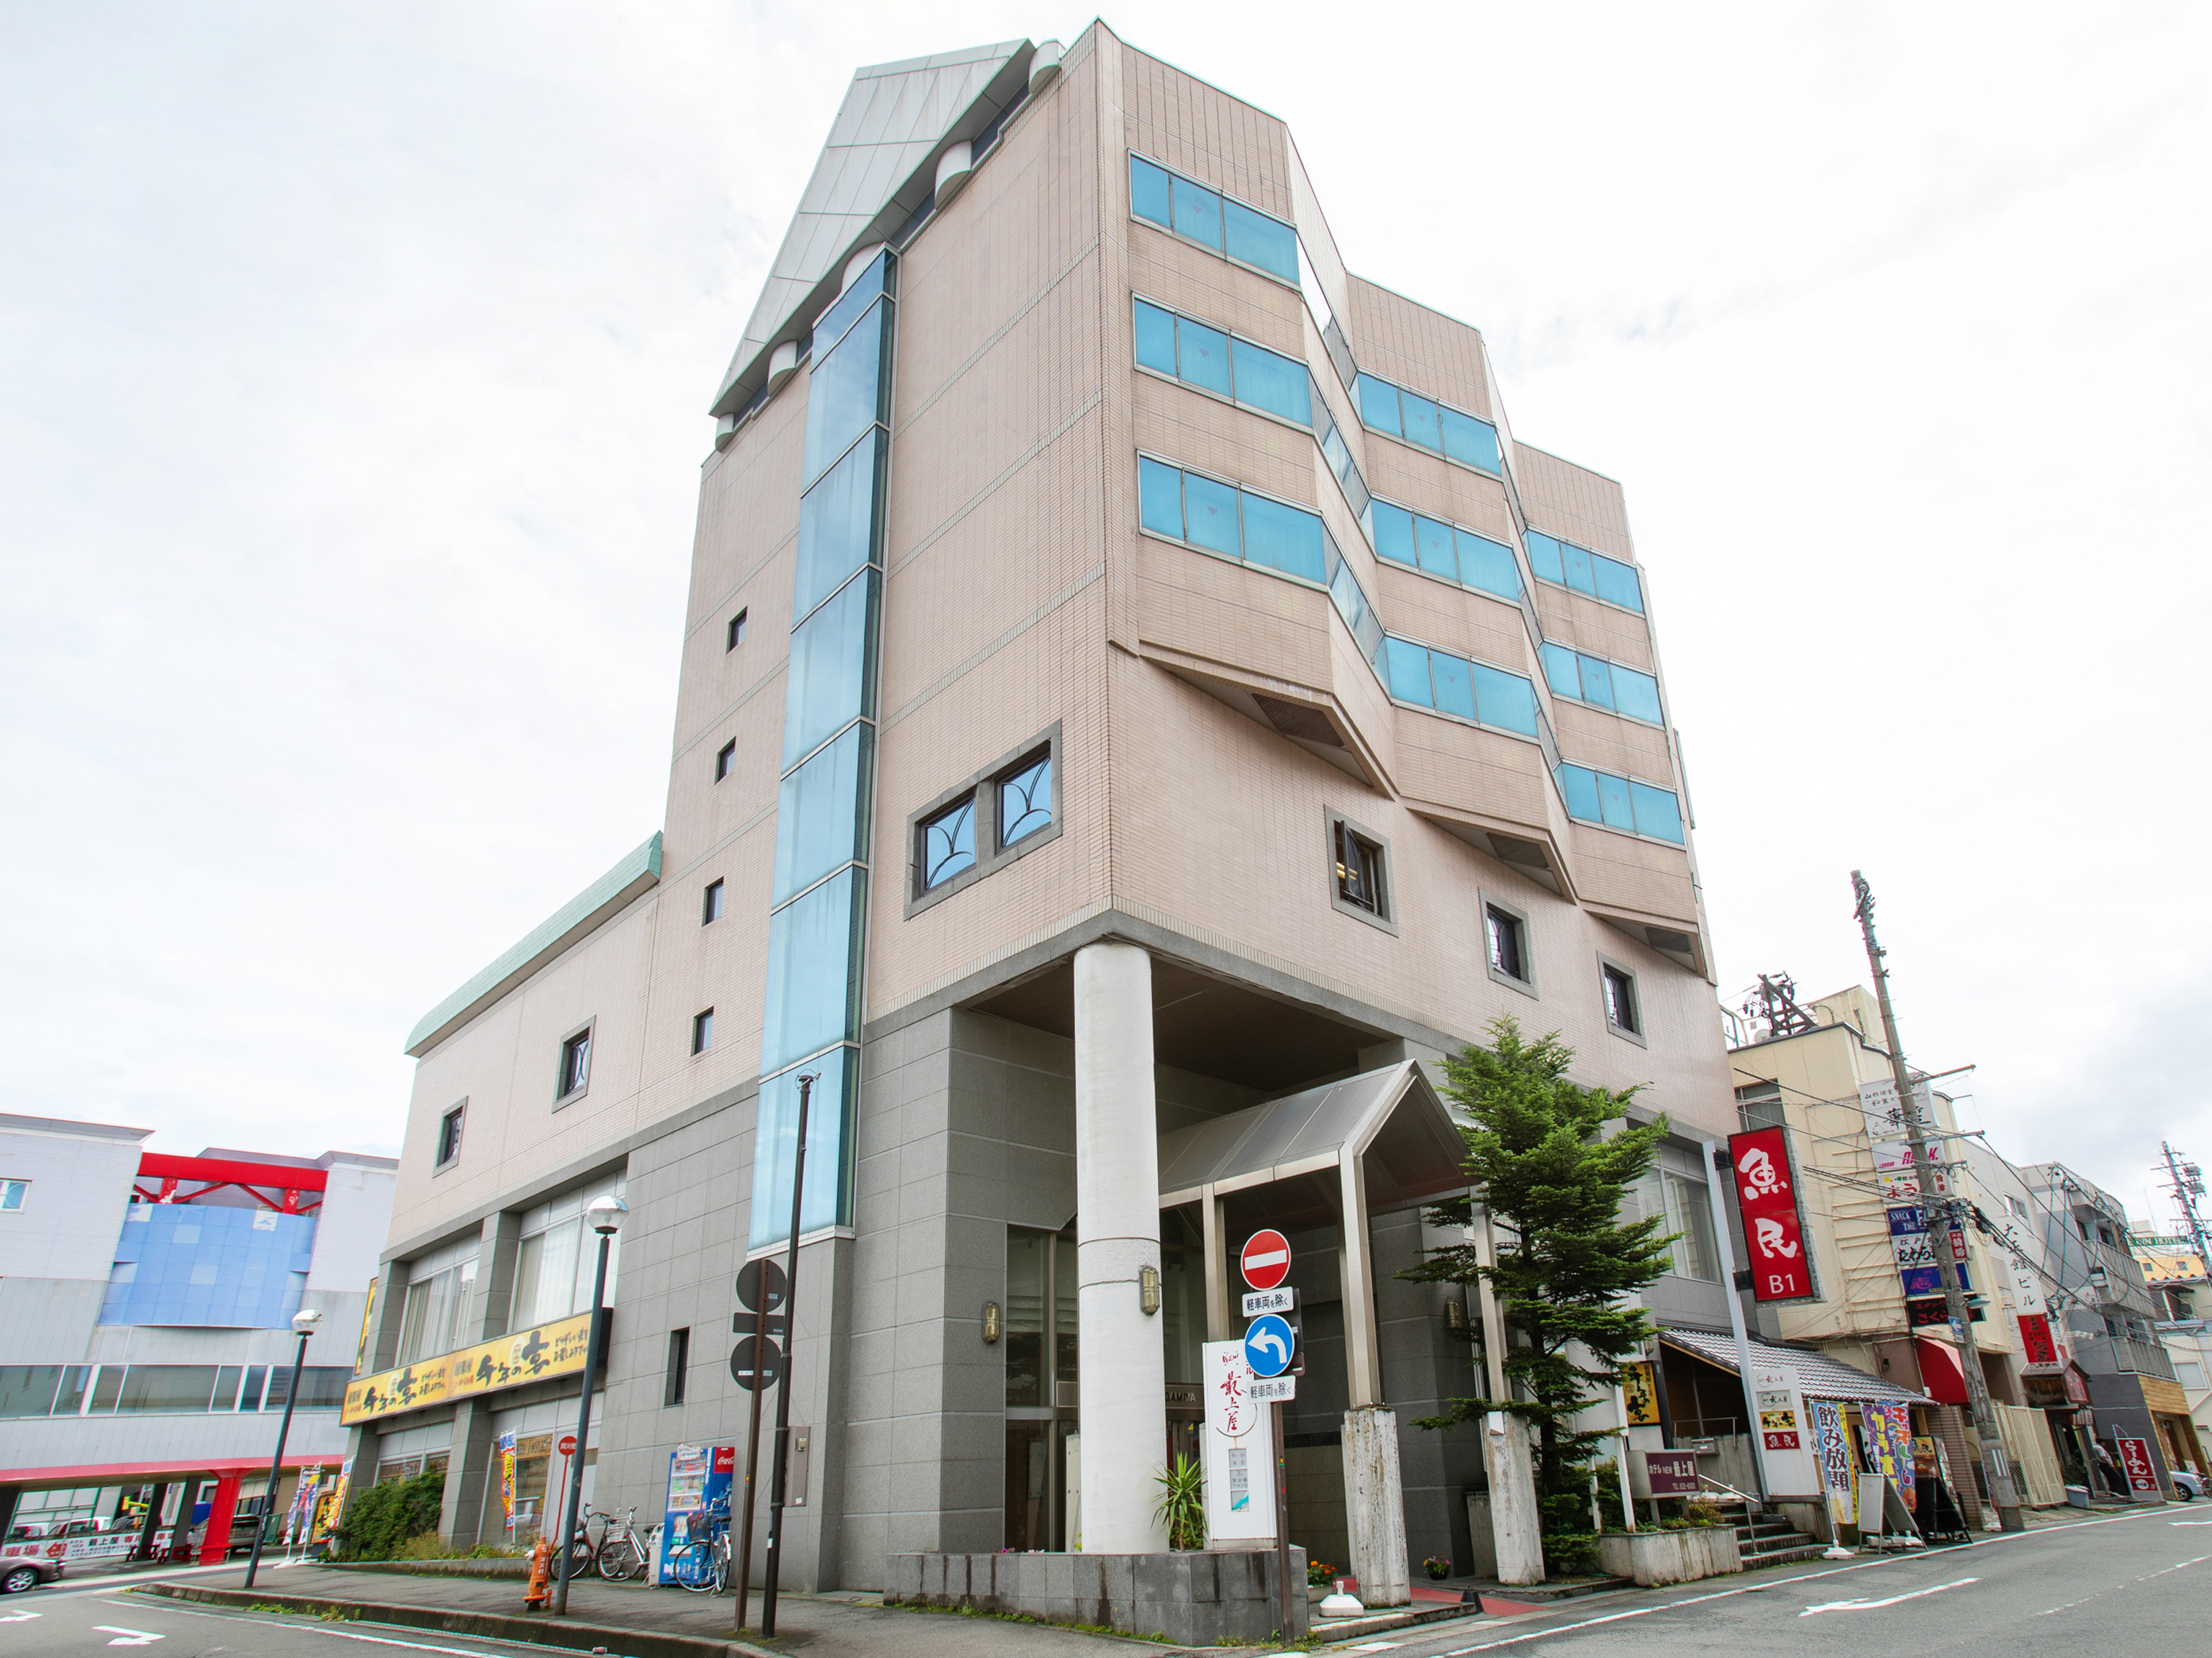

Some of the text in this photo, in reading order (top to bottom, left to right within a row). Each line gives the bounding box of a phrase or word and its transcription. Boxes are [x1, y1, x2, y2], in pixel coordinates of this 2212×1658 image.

[1738, 1148, 1798, 1259] 魚民
[1890, 1211, 1911, 1221] SNACK
[1769, 1274, 1795, 1294] B1
[1246, 1294, 1288, 1311] 軽車両を除く
[476, 1330, 550, 1388] 千年の宴
[1250, 1381, 1292, 1399] 軽車両を除く
[1768, 1434, 1795, 1448] 魚民
[1816, 1405, 1851, 1492] 飲み放題
[2125, 1440, 2148, 1475] らーめん
[1649, 1464, 1662, 1474] ホテル
[1673, 1461, 1695, 1477] 最上屋
[0, 1544, 40, 1557] 車場
